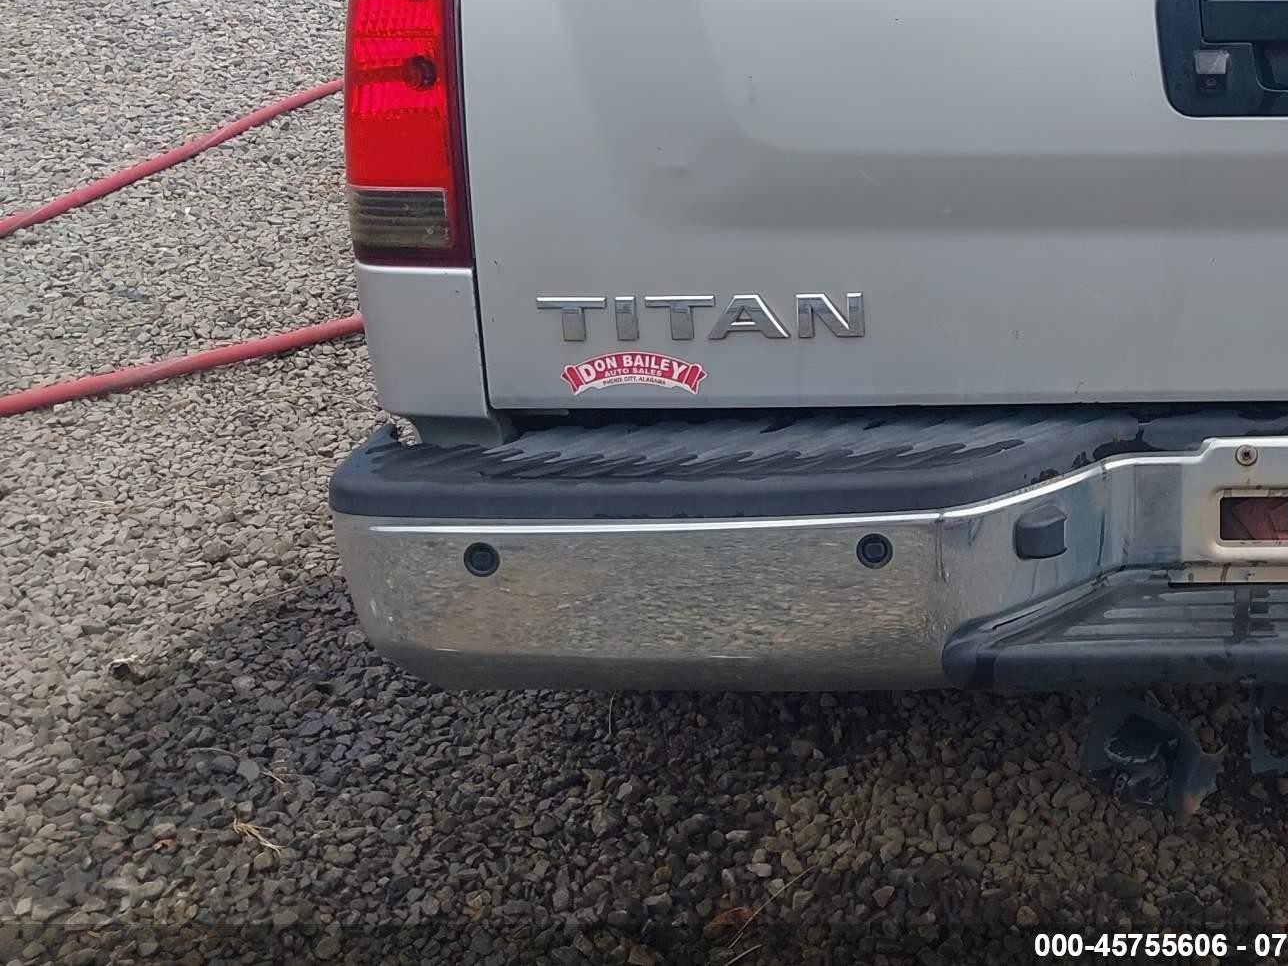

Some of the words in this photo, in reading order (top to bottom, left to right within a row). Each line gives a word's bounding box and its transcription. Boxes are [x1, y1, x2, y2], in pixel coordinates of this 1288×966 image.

[536, 292, 866, 342] TITAN
[579, 357, 618, 382] DON
[622, 354, 690, 380] BAILEY
[604, 367, 630, 378] AUTO
[632, 367, 663, 377] SALES
[639, 375, 667, 386] ALABAMA
